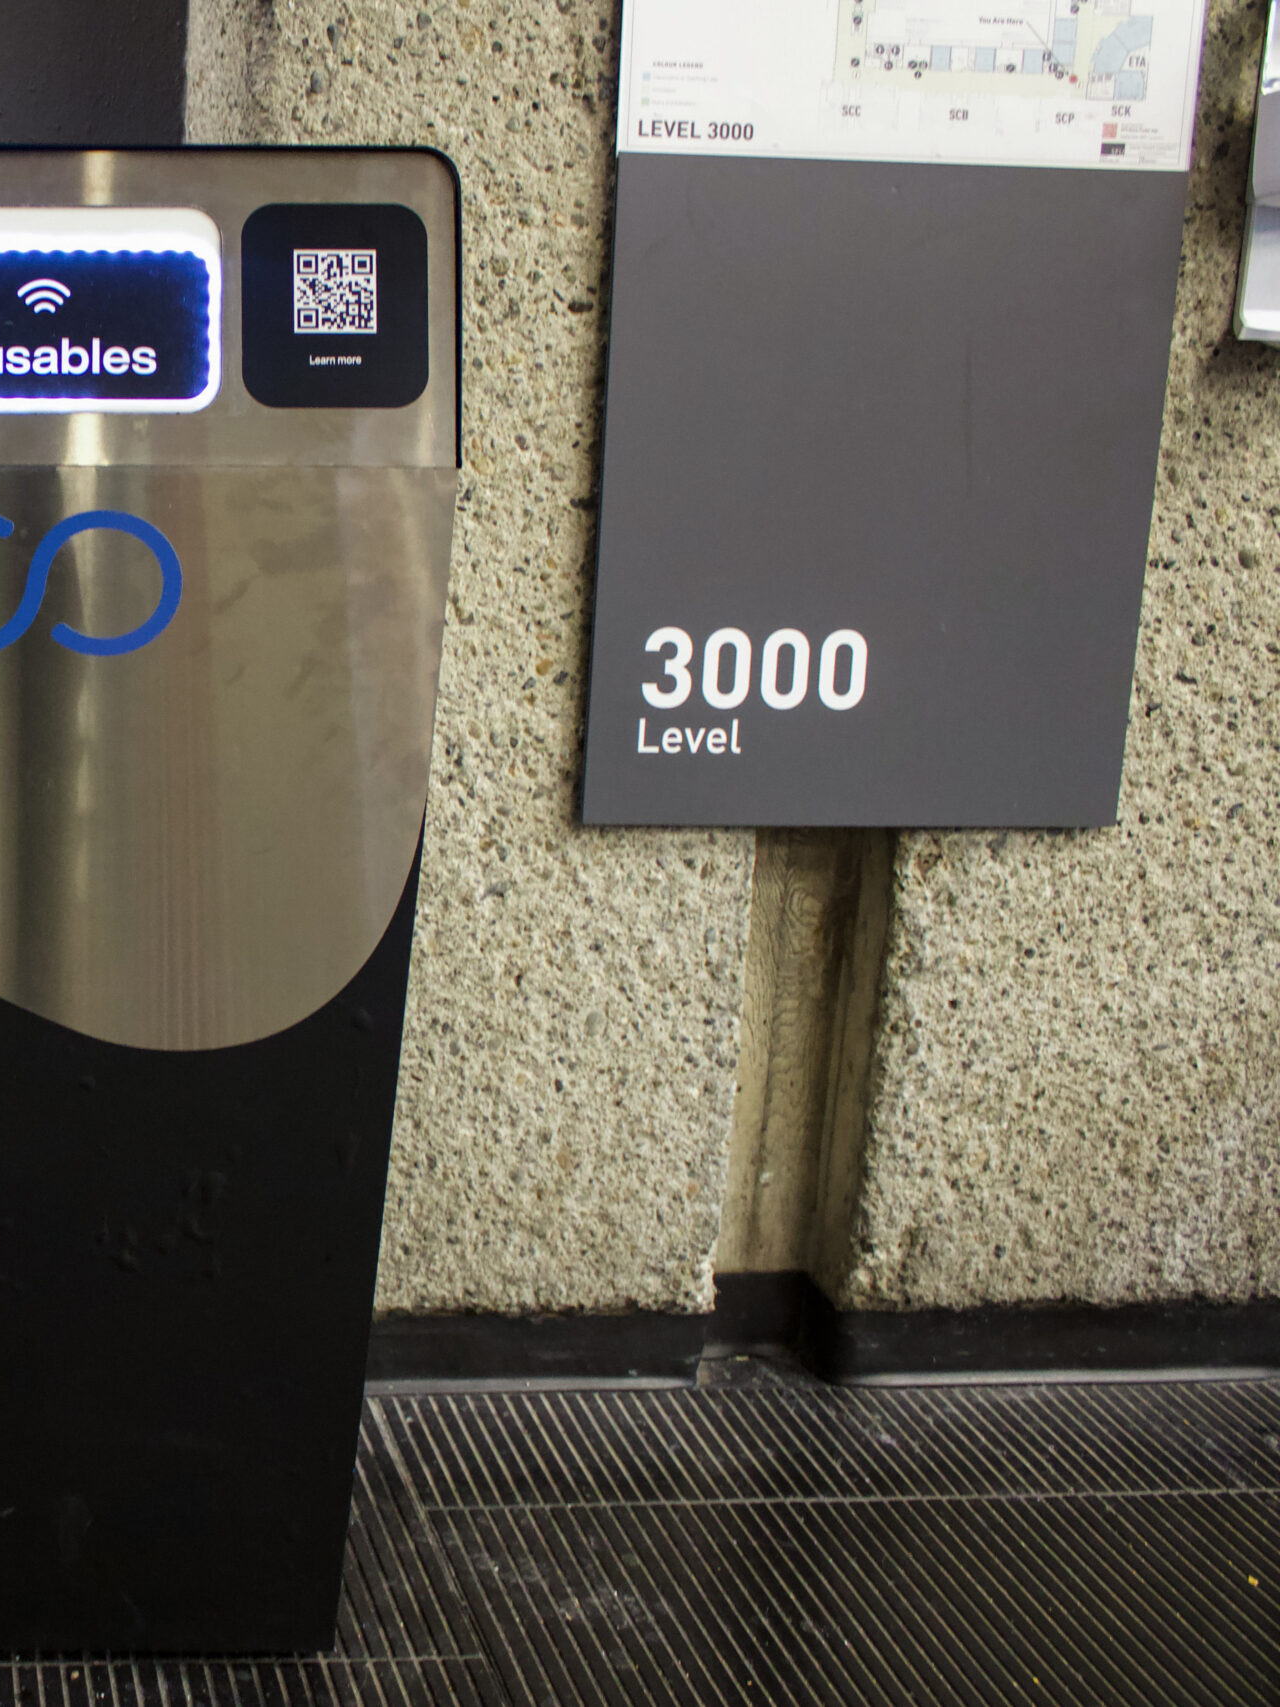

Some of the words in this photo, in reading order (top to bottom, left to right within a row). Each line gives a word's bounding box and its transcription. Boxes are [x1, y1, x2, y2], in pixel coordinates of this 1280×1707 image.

[842, 105, 861, 117] SCC
[1111, 105, 1131, 117] SCK
[1055, 112, 1075, 124] SCP
[638, 119, 701, 139] LEVEL
[707, 122, 754, 140] 3000
[309, 354, 336, 366] Learn
[337, 356, 362, 366] more
[641, 626, 868, 710] 3000
[637, 717, 741, 754] Level
